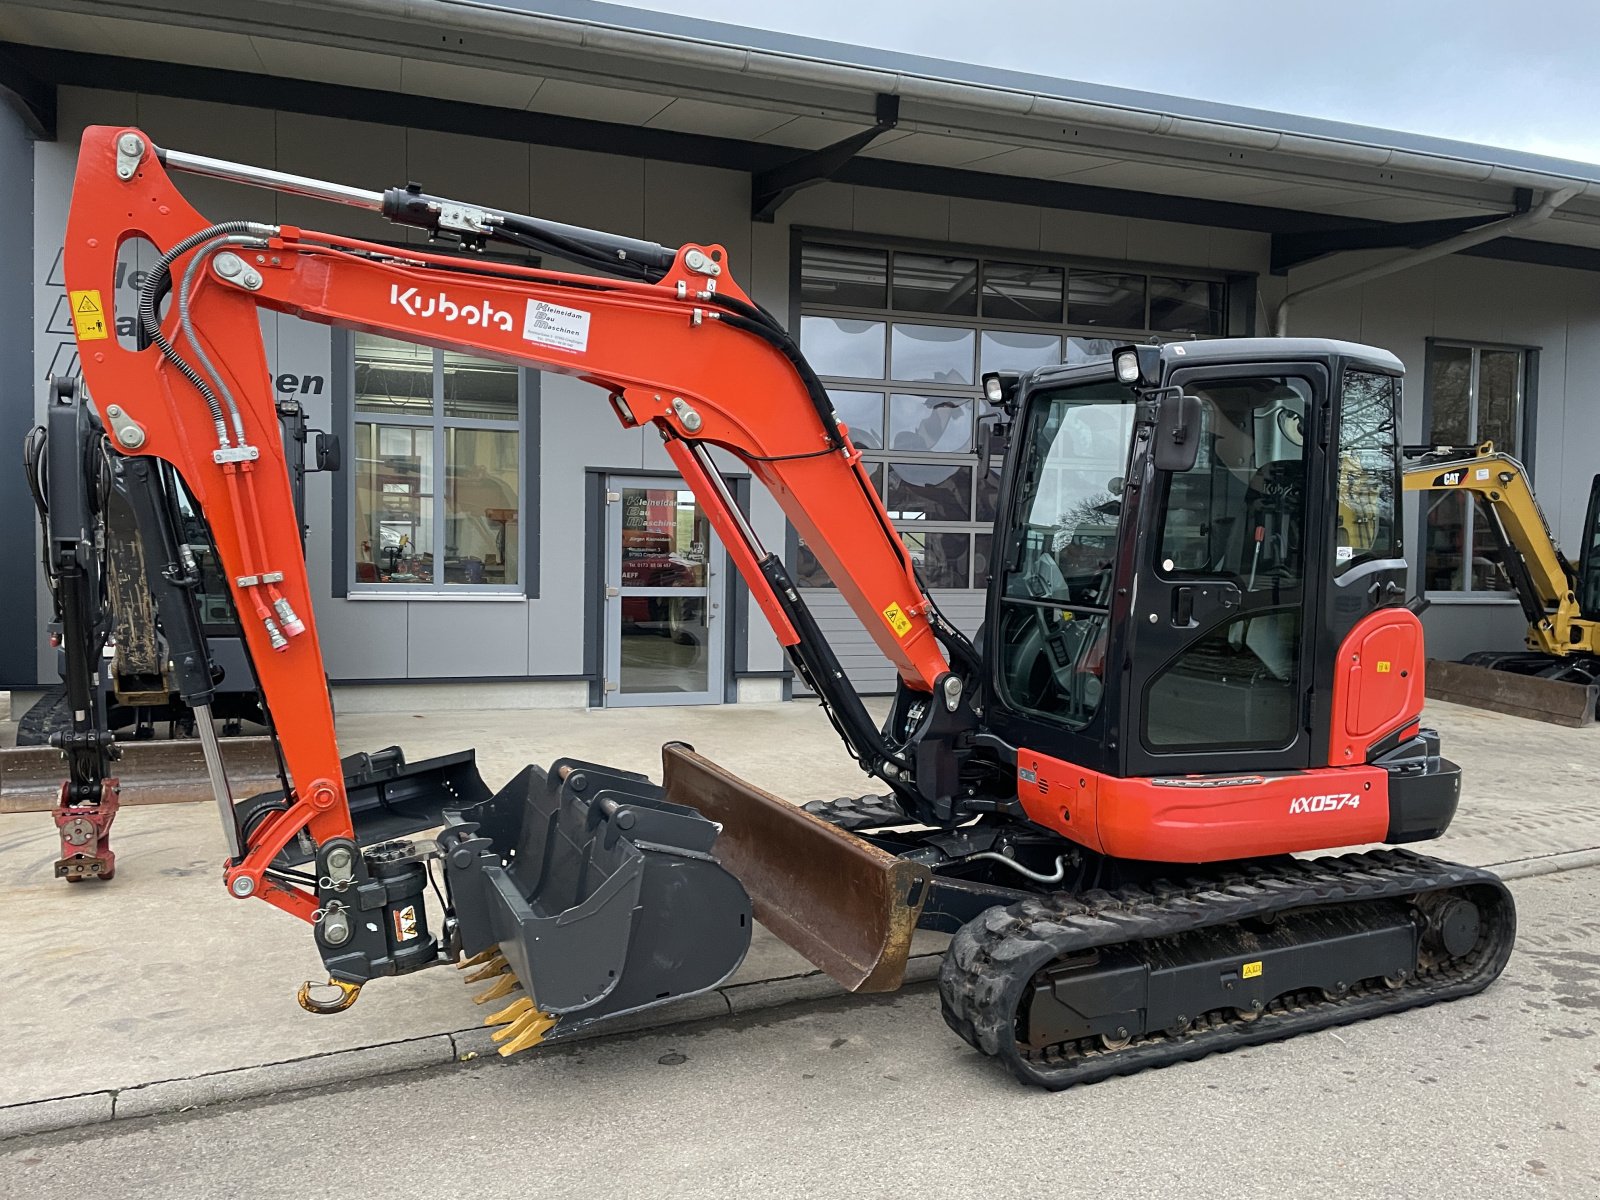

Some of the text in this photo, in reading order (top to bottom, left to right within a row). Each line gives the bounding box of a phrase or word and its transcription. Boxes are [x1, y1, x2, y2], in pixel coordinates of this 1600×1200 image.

[390, 284, 513, 332] Kubota
[535, 302, 583, 320] Kleineidam
[534, 311, 555, 322] Bau
[534, 320, 580, 336] Maschinen
[1443, 472, 1460, 486] CAT
[626, 506, 650, 516] Bau
[626, 516, 680, 527] Maschine
